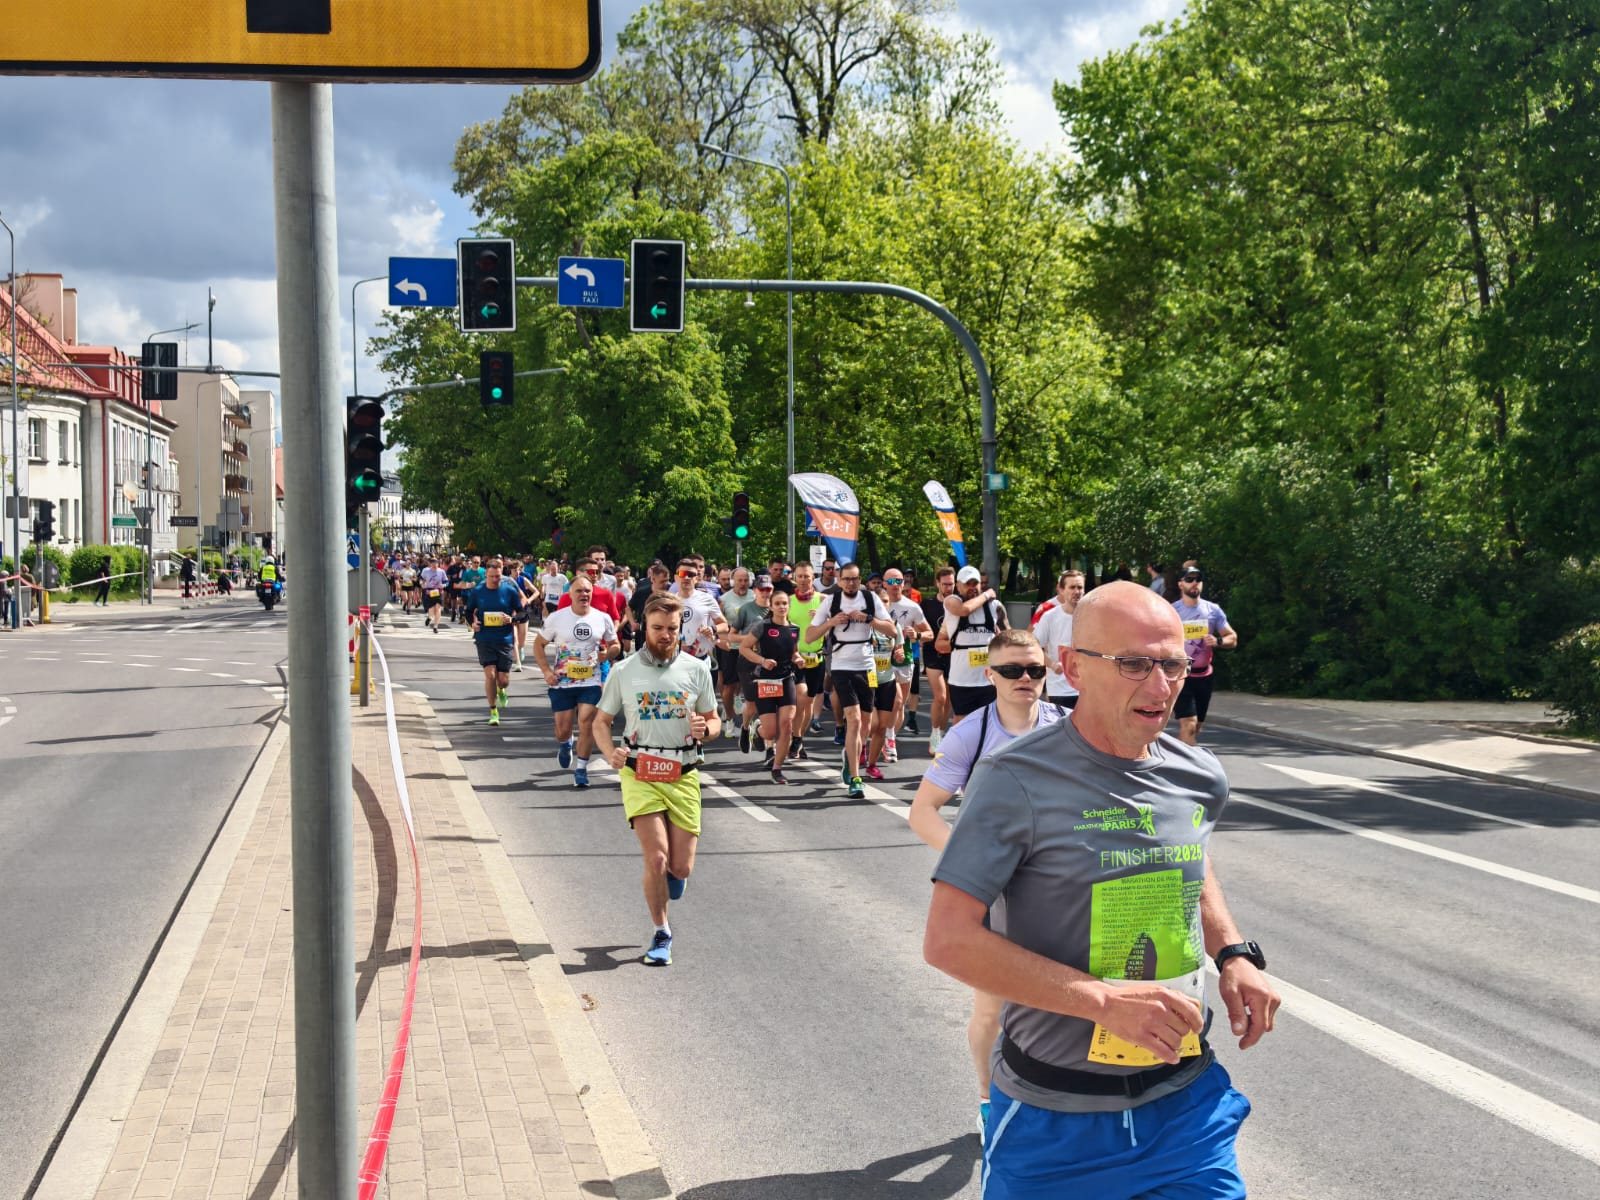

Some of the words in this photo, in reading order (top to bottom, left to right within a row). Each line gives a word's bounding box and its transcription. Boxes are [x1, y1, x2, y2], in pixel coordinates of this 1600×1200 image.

[646, 760, 674, 772] 1300
[1082, 806, 1127, 819] Schneider
[1104, 819, 1137, 831] PARIS
